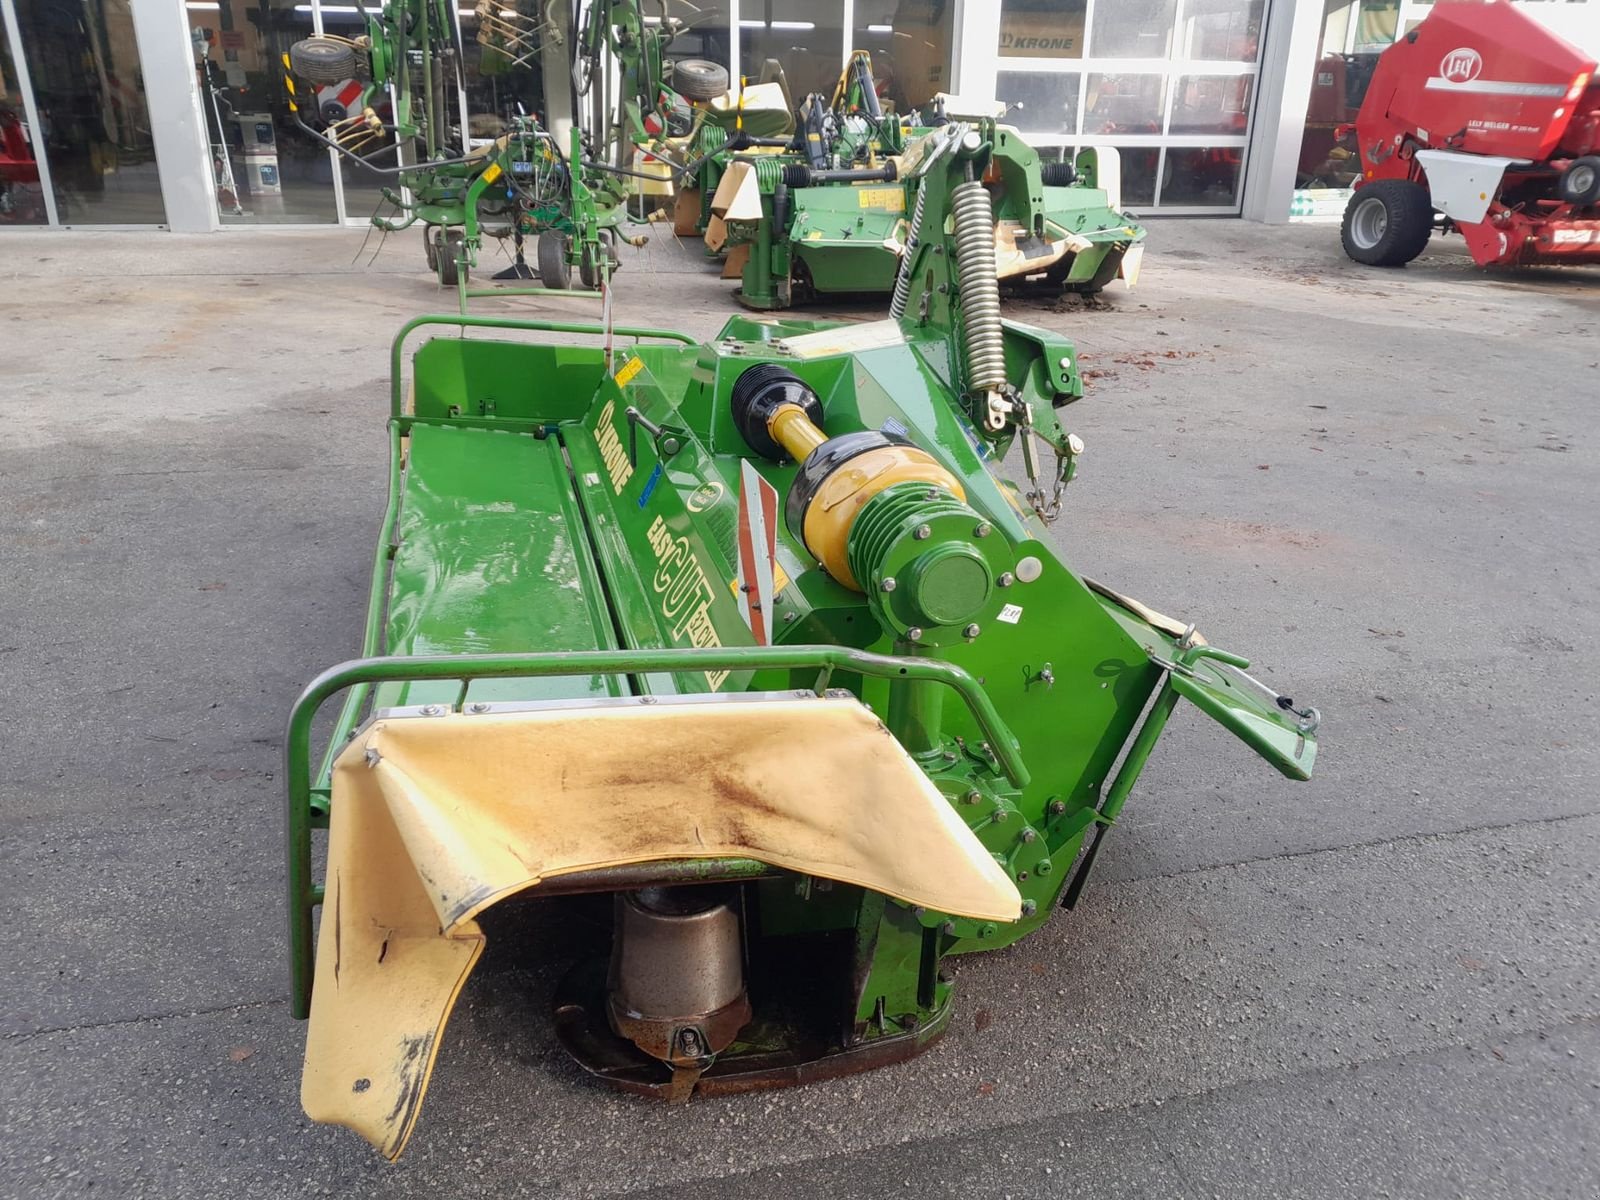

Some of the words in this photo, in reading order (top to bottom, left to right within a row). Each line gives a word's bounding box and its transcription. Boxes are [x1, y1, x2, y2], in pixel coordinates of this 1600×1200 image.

[1014, 37, 1073, 49] KRONE
[1446, 55, 1475, 78] LELY
[1468, 119, 1483, 127] LELY
[598, 422, 634, 496] KRONE
[690, 611, 706, 635] 32
